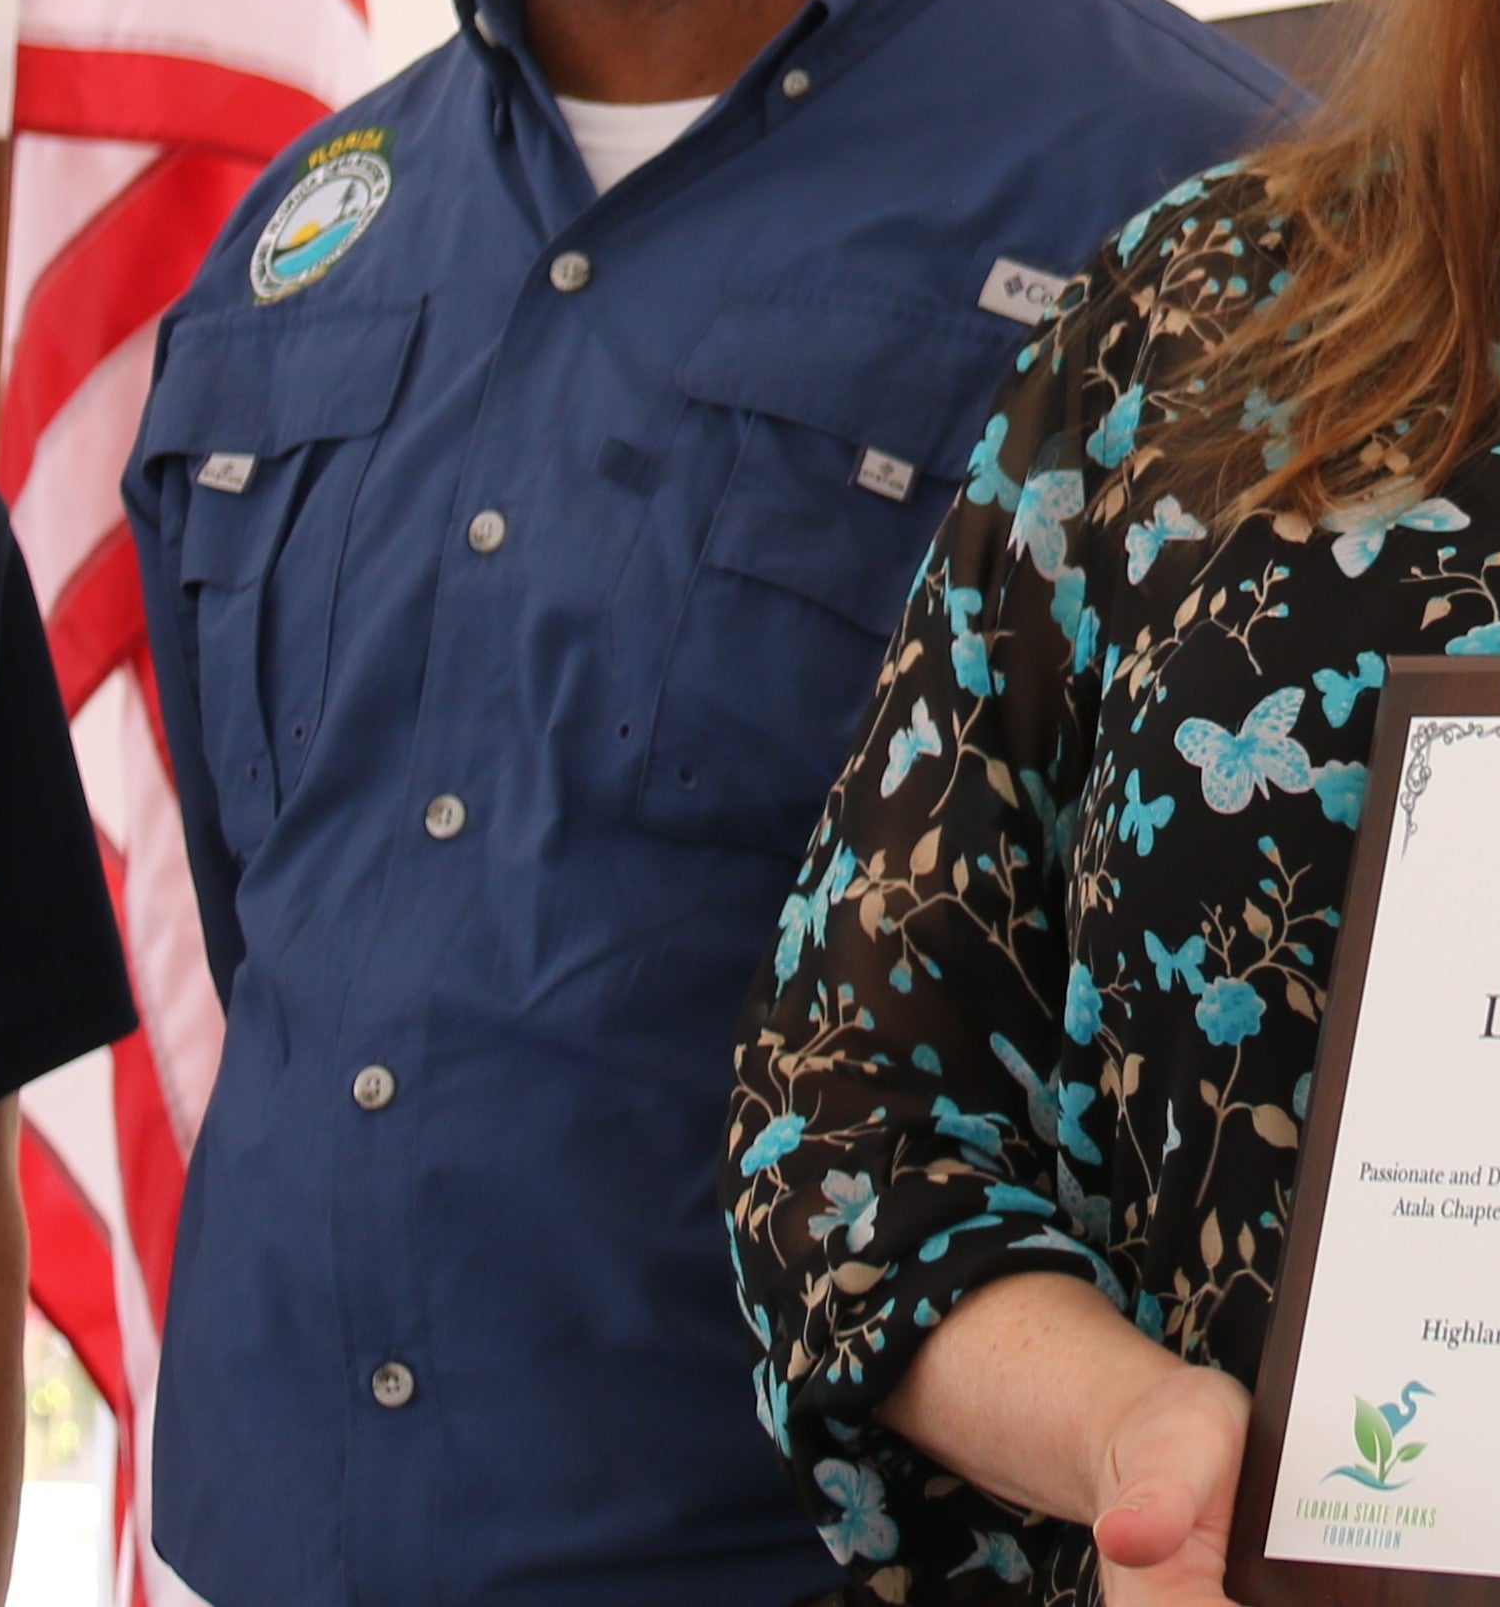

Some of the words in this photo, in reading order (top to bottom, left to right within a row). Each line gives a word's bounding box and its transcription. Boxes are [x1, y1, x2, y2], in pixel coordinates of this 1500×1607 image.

[1358, 1161, 1445, 1185] Passionate
[1448, 1164, 1483, 1187] and
[1392, 1196, 1435, 1219] Atala
[1296, 1498, 1349, 1521] FLORIDA
[1354, 1502, 1389, 1524] STATE
[1395, 1505, 1437, 1528] PARKS
[1322, 1524, 1402, 1550] FOUNDATION
